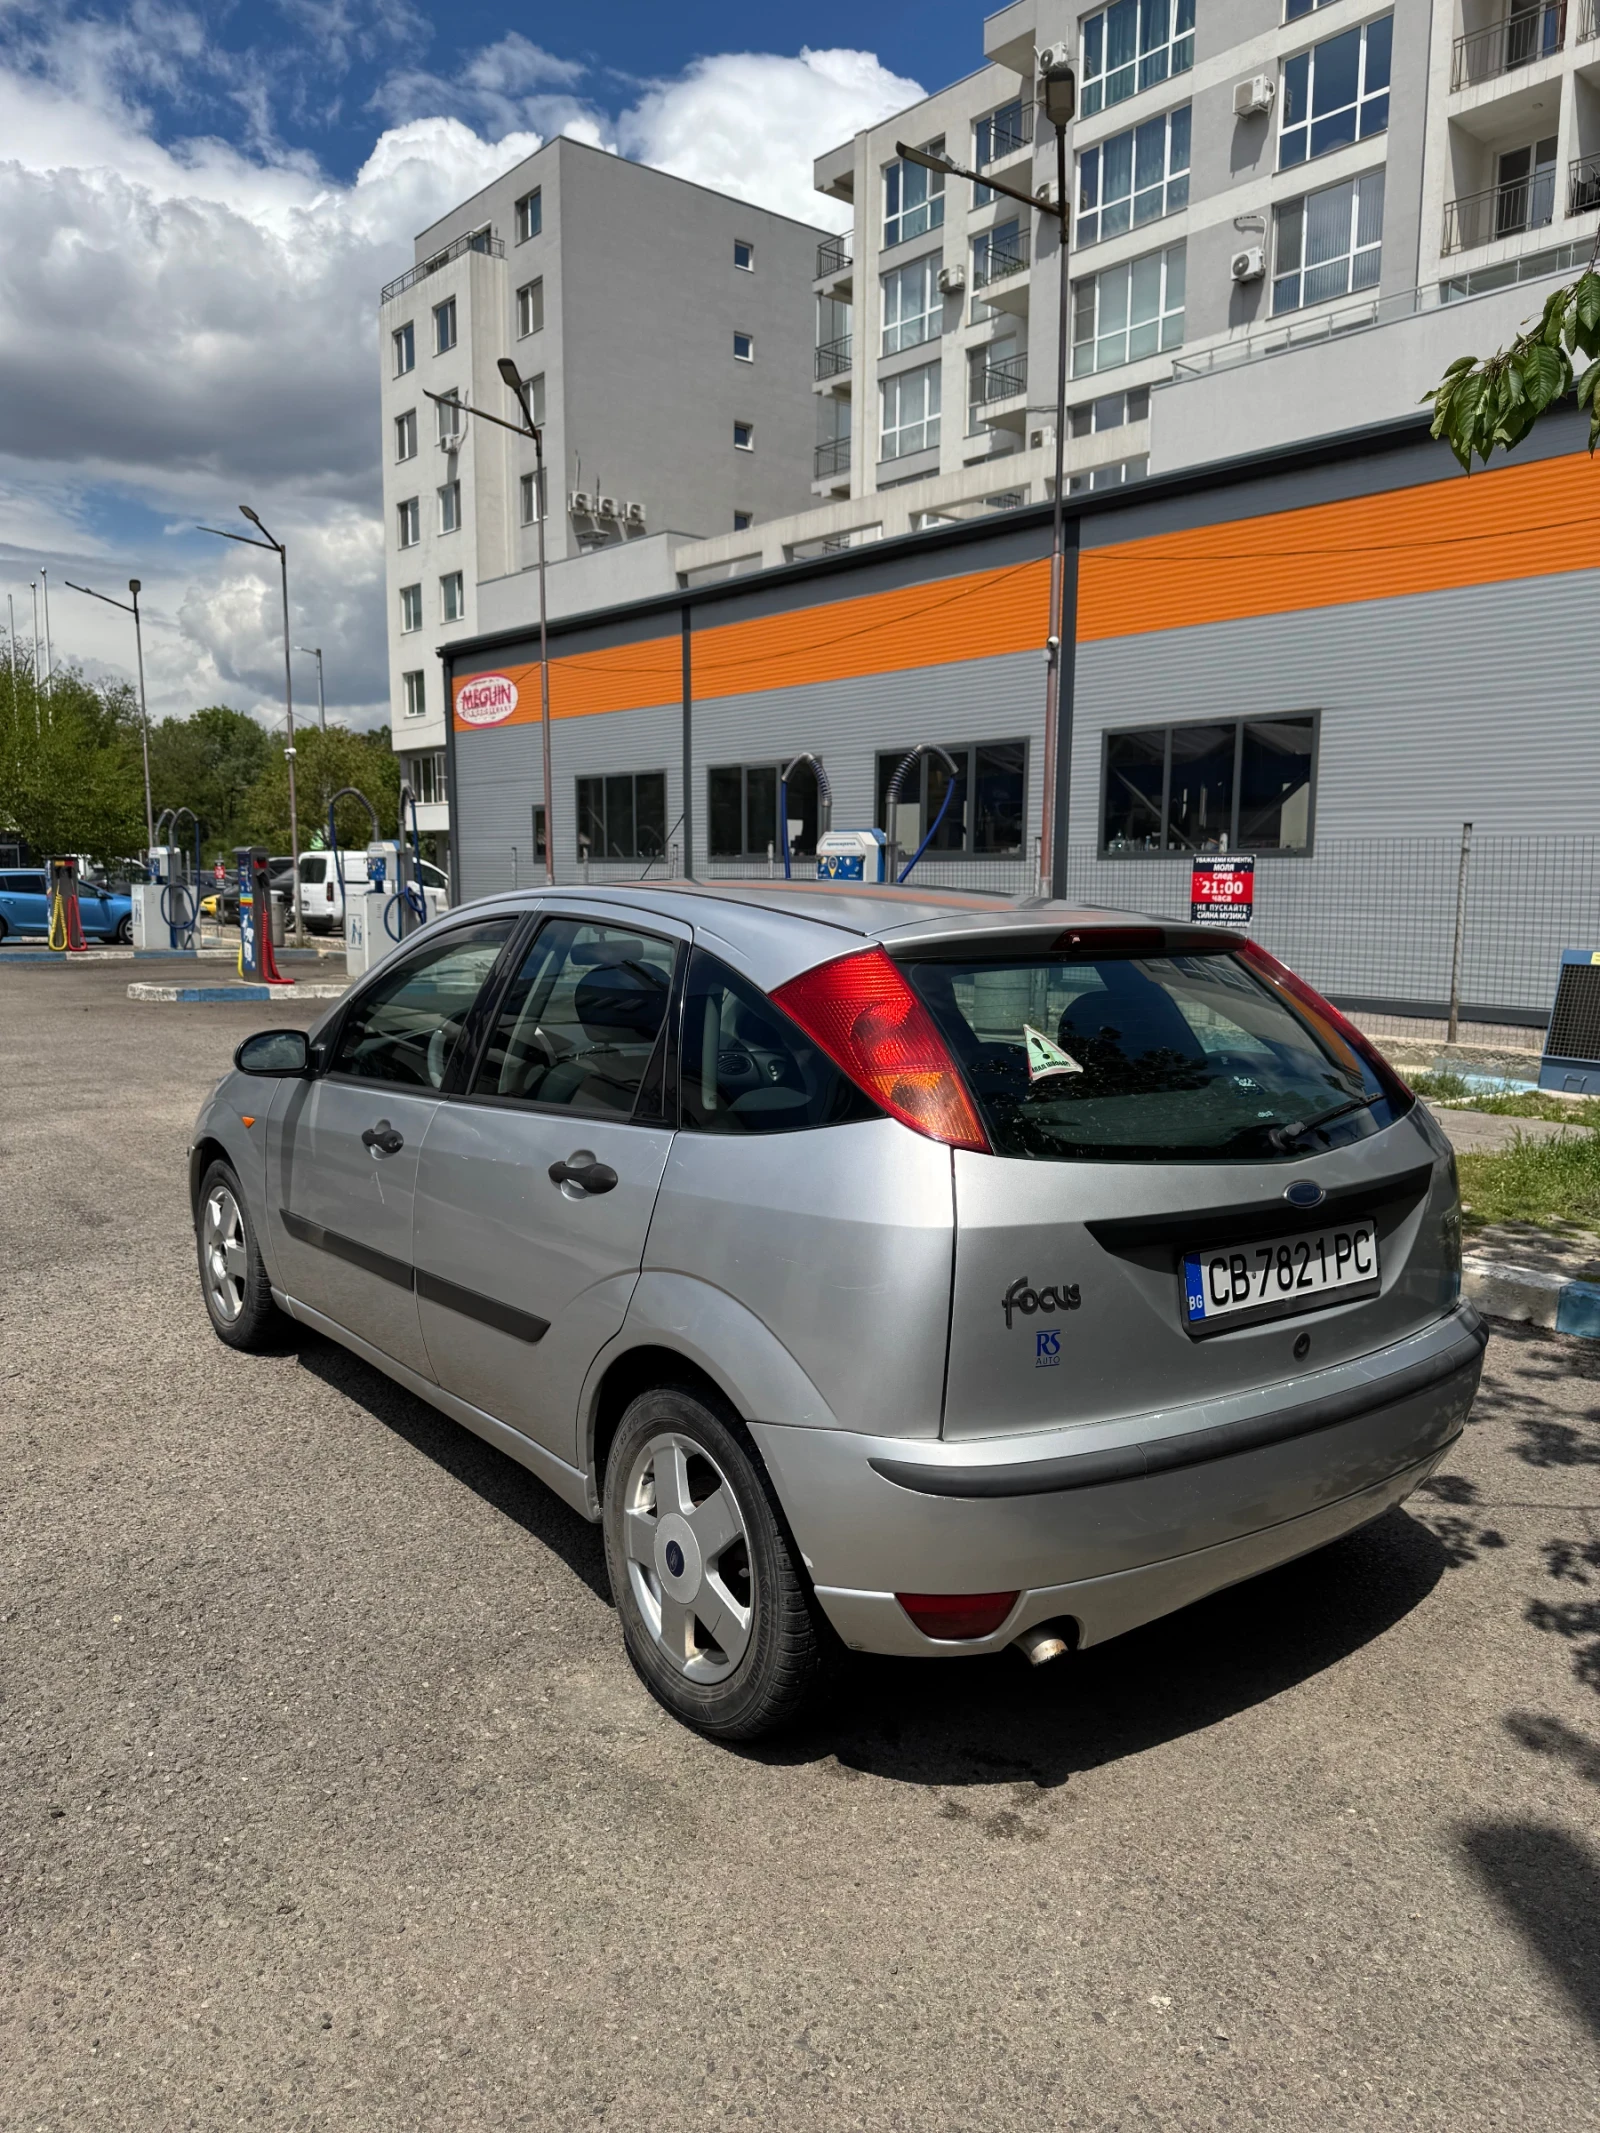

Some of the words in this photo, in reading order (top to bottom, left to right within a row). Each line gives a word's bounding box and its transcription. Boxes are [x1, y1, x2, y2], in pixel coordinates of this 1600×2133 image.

[1201, 881, 1243, 894] 21:00
[1189, 1295, 1203, 1311] BG
[1036, 1332, 1061, 1356] RS
[1036, 1356, 1061, 1365] AUTO
